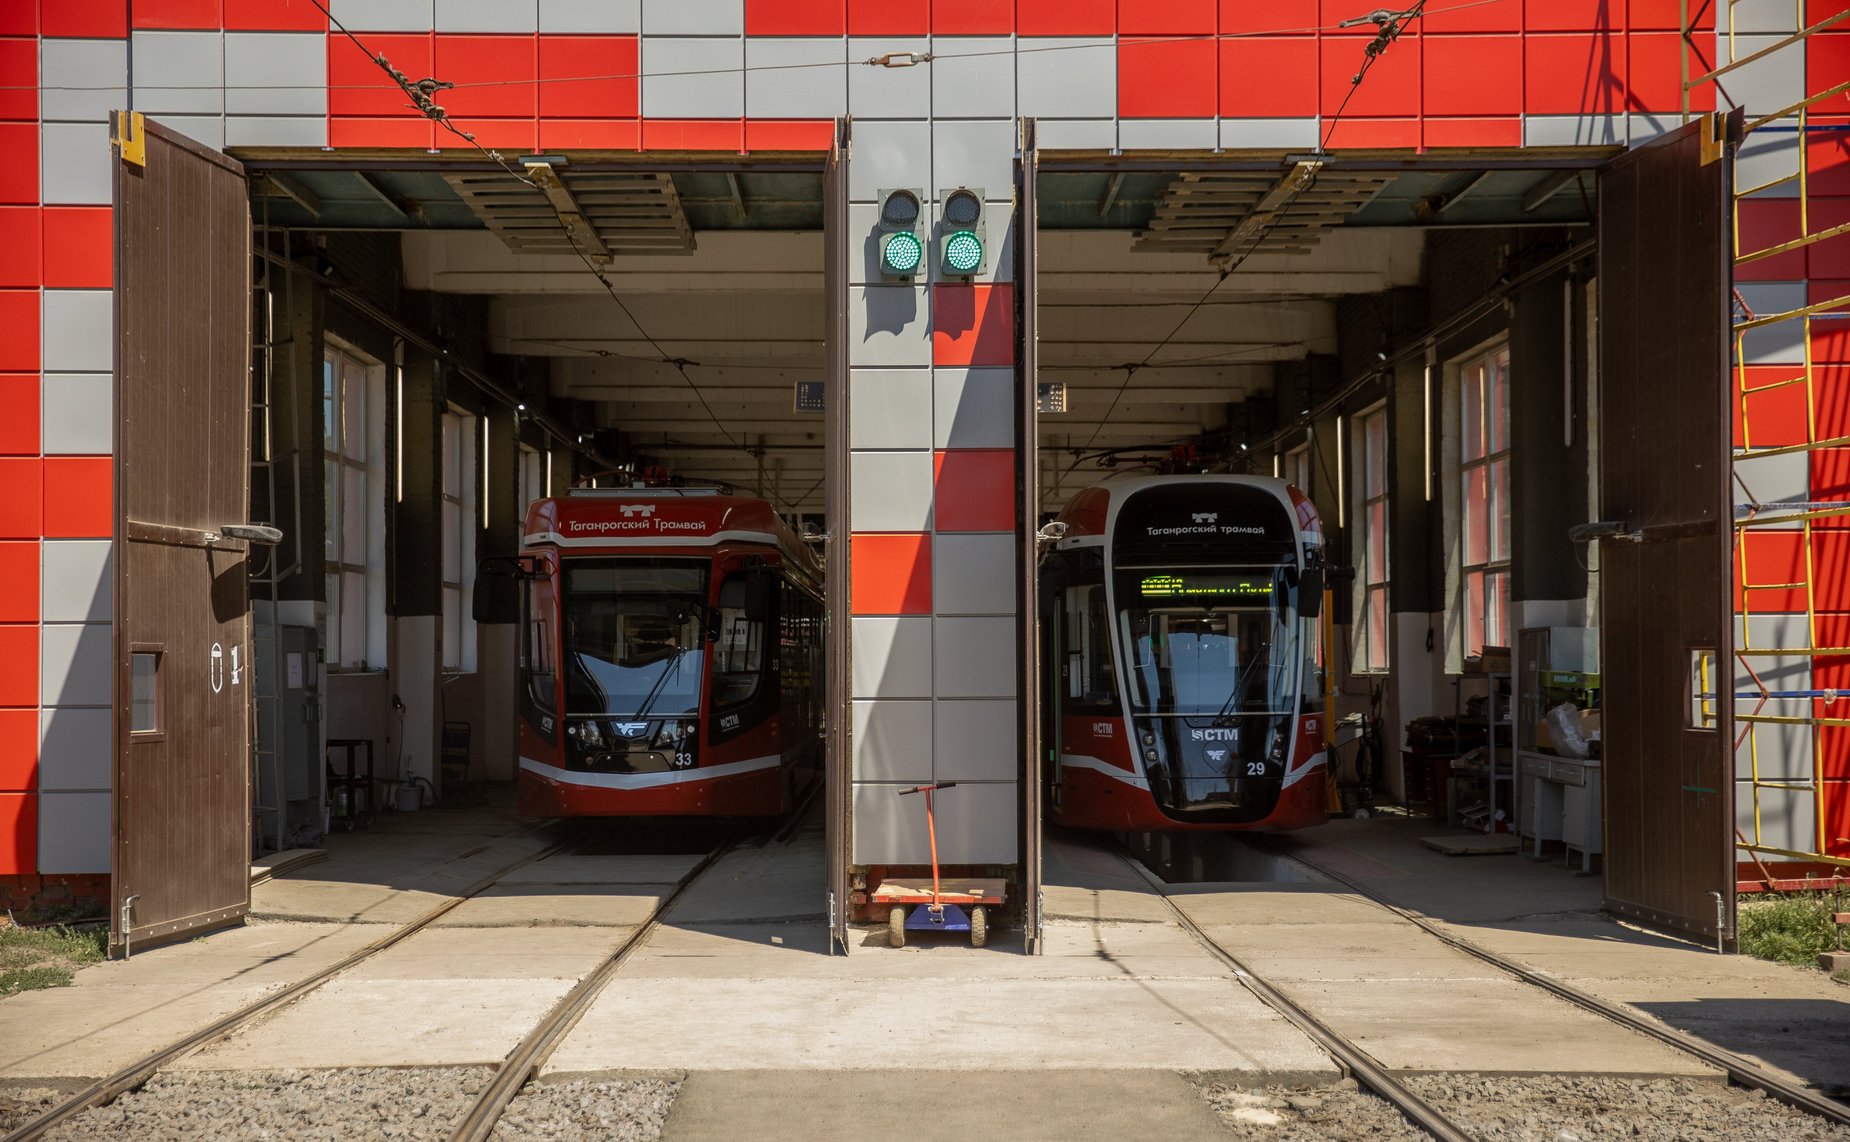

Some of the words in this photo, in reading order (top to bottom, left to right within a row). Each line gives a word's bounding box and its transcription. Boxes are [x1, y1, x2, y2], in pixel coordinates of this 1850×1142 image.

[569, 520, 650, 533] Таганрогский
[654, 518, 706, 532] Трамвай
[1147, 525, 1217, 536] Таганрогский
[1220, 526, 1265, 535] трамвай
[1098, 722, 1113, 734] СТМ
[1204, 728, 1239, 741] СТМ
[675, 752, 692, 766] 33
[1246, 762, 1266, 776] 29
